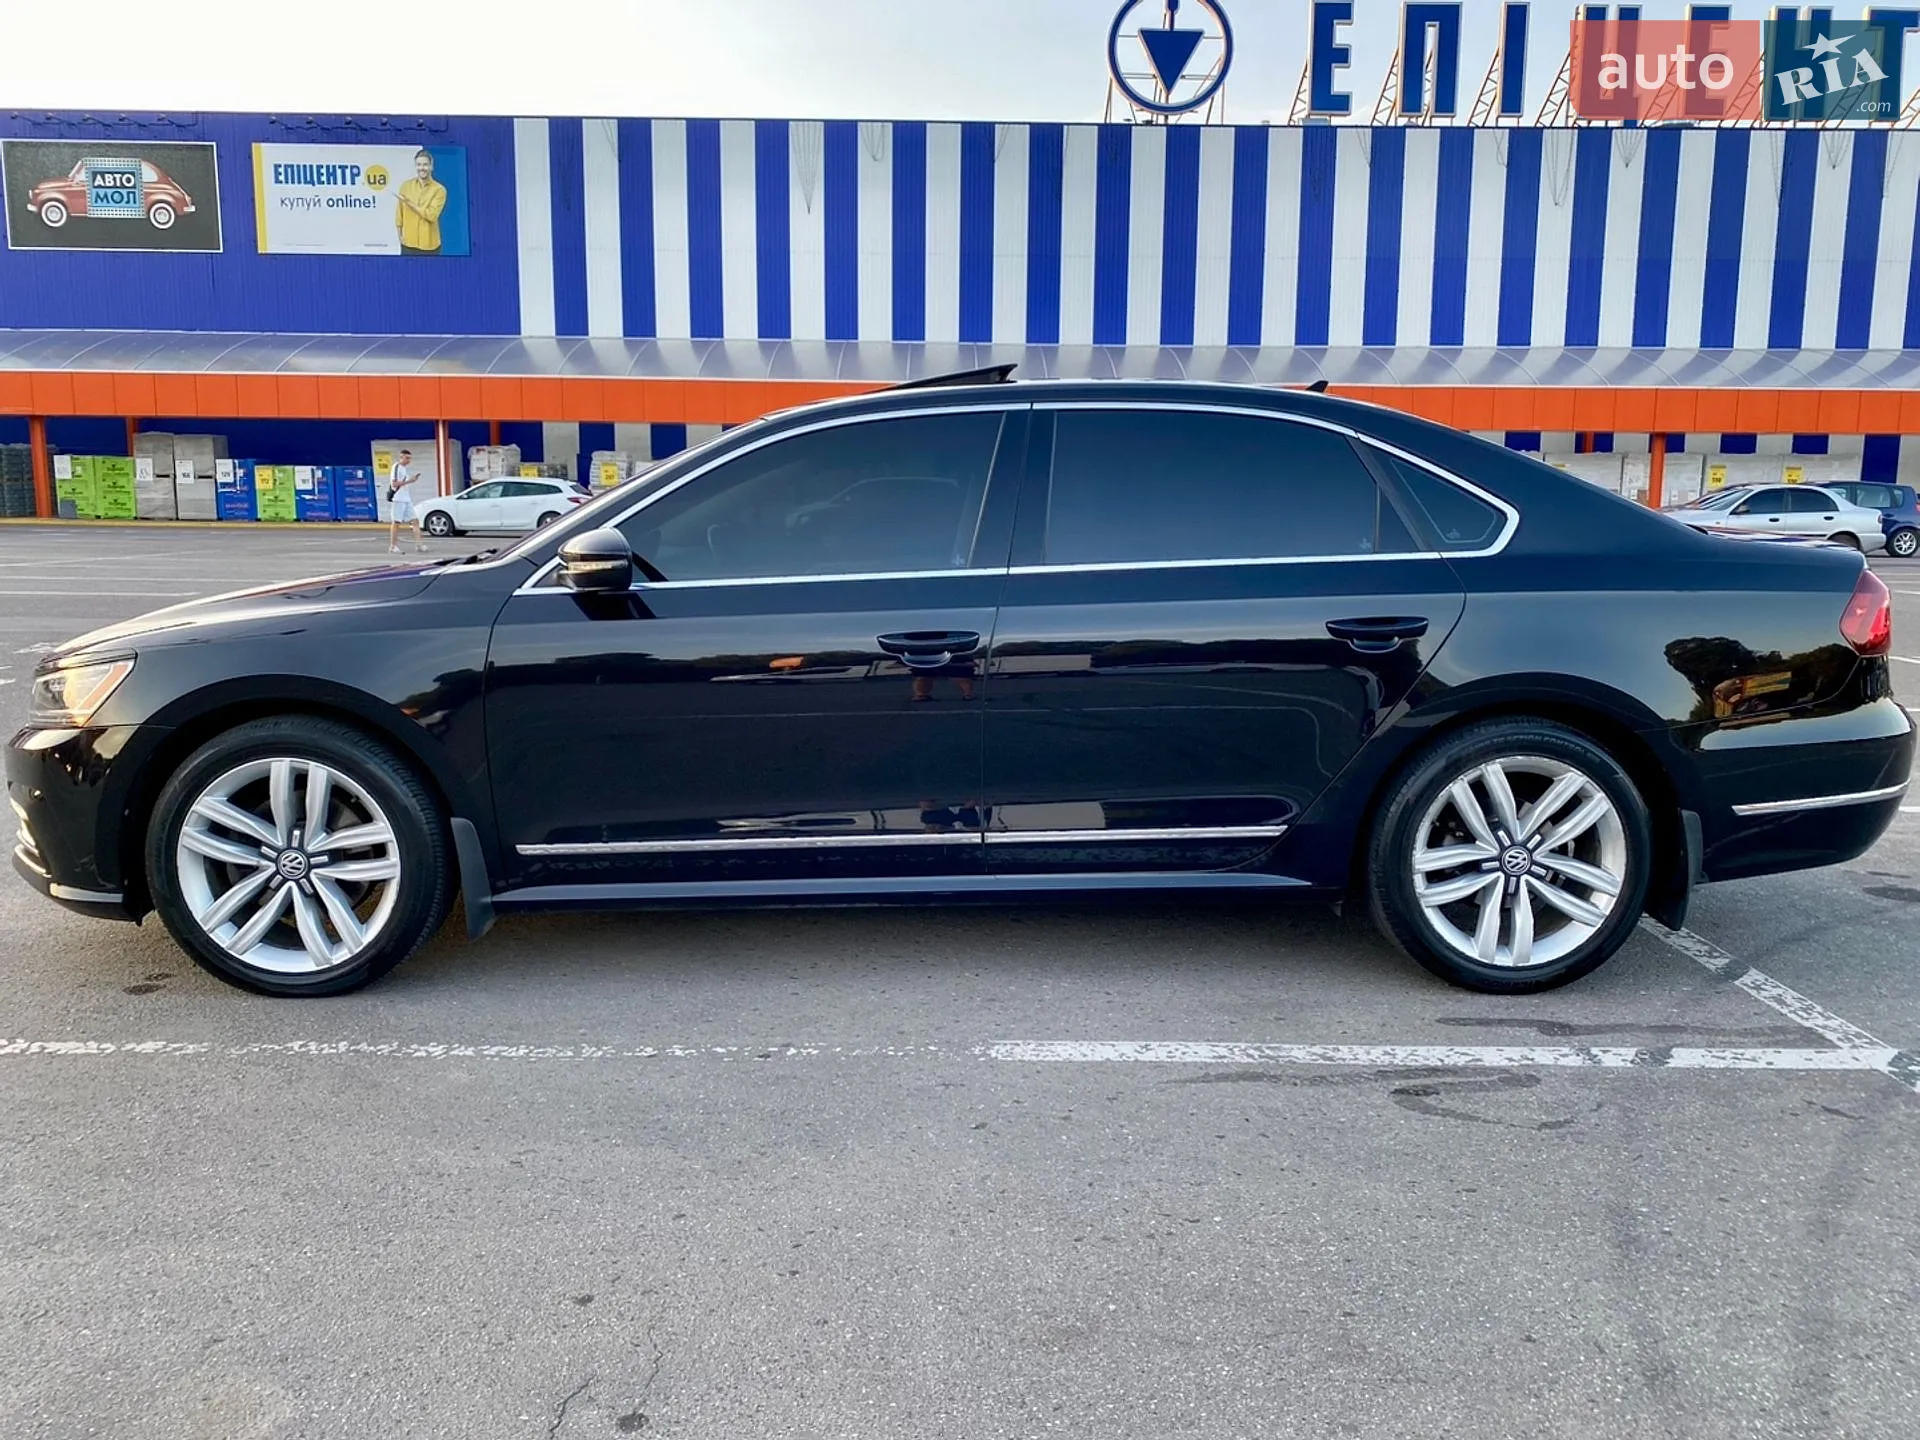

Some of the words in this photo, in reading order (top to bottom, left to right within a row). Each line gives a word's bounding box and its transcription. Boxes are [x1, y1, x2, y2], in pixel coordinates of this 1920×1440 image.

[93, 173, 135, 187] АВТО
[94, 190, 137, 205] МОЛ
[280, 195, 321, 211] купуй
[326, 194, 377, 208] online!
